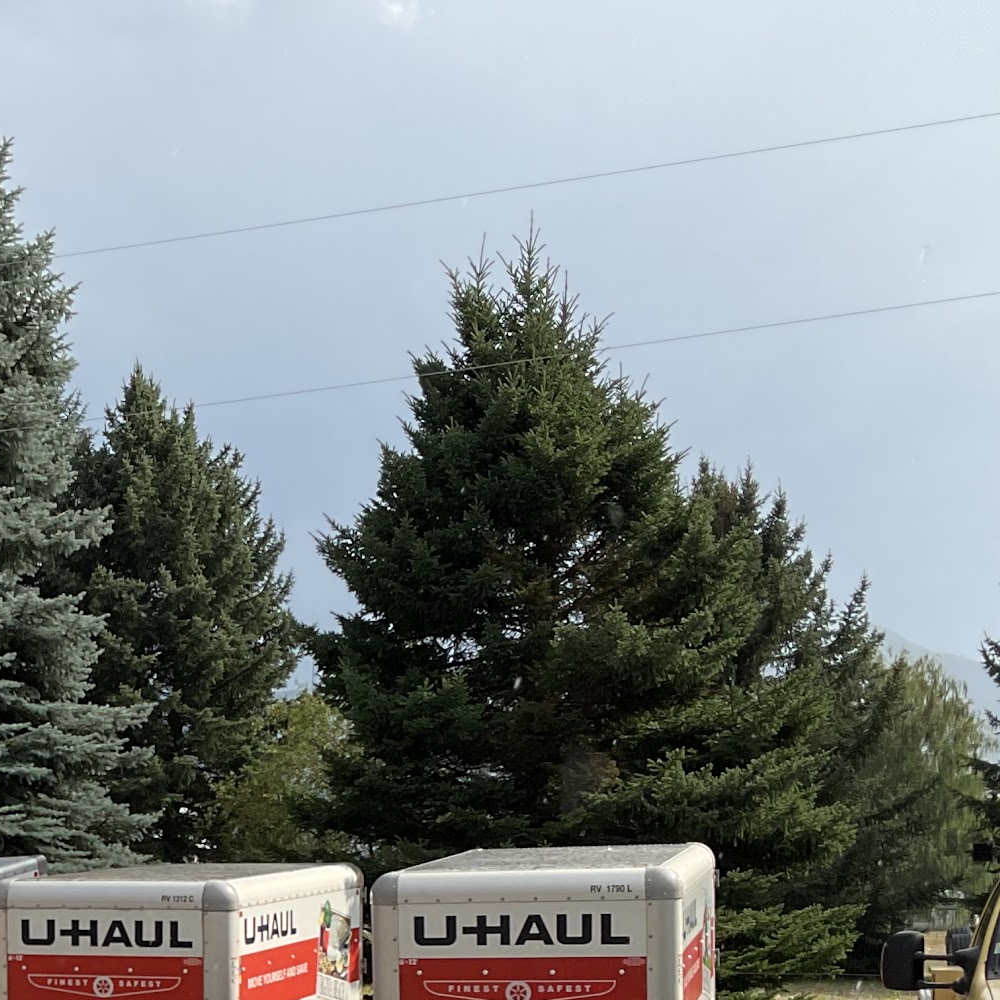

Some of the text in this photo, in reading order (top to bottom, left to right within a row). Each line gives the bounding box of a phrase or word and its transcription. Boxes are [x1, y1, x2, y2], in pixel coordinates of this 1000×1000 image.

[590, 884, 633, 893] RV 1790 L
[161, 895, 171, 903] RV
[21, 919, 193, 948] U-HAUL
[244, 909, 297, 946] U-HAUL
[414, 913, 631, 946] U-HAUL
[46, 978, 162, 988] FINEST SAFEST
[247, 975, 263, 990] MOVE
[448, 984, 592, 994] FINEST SAFEST
